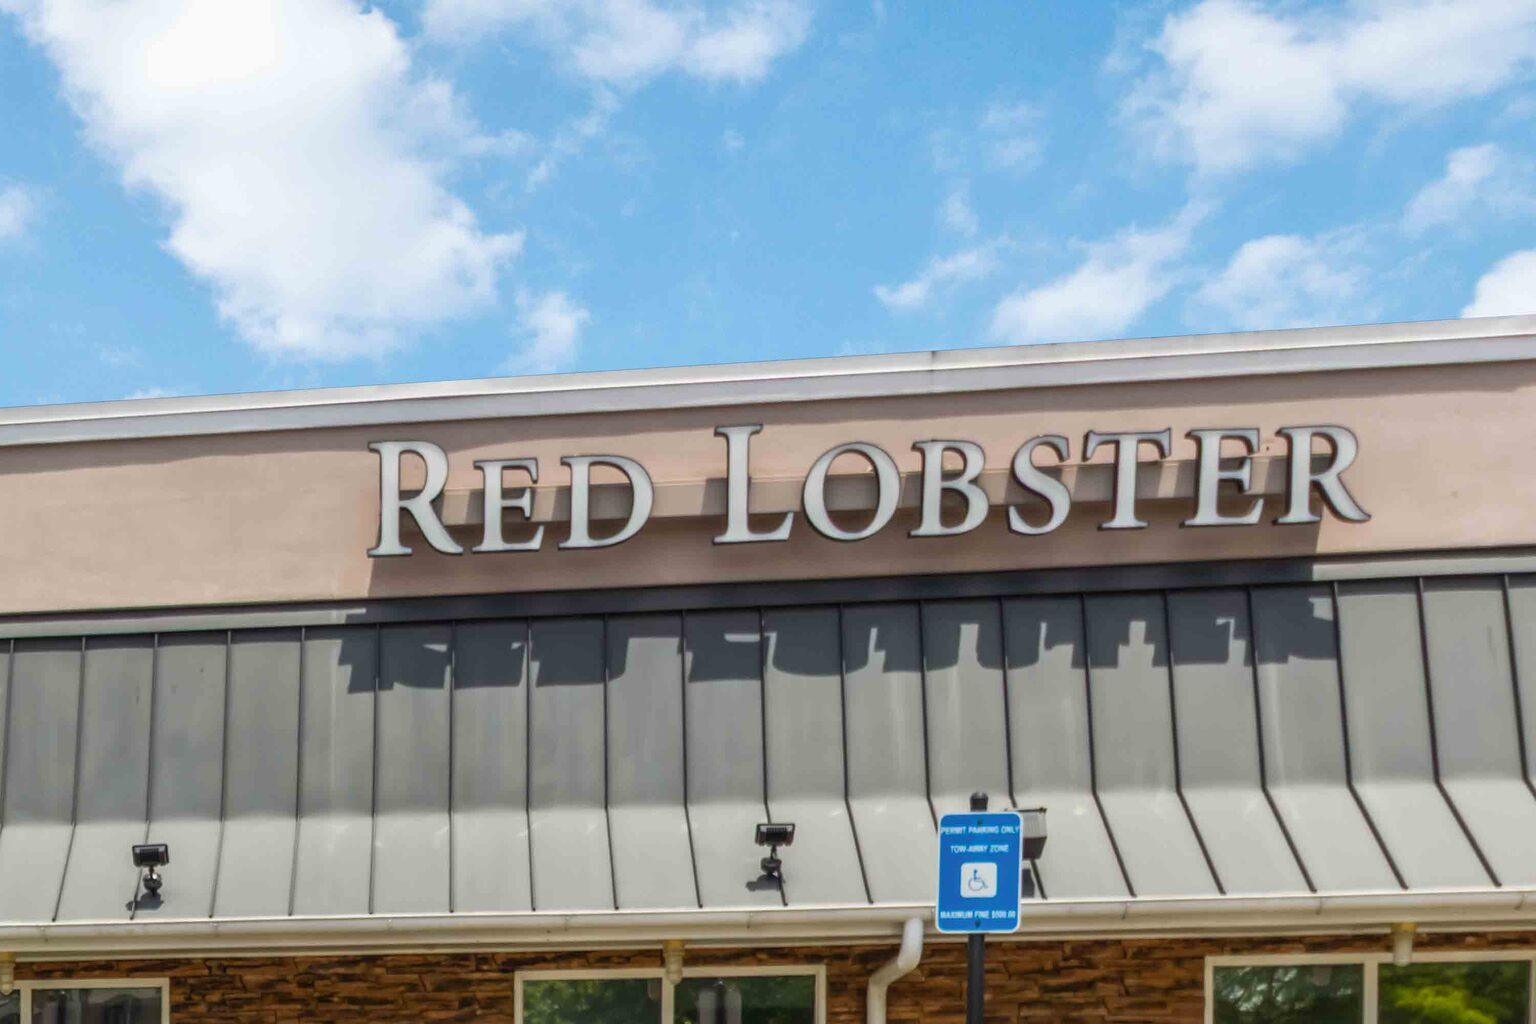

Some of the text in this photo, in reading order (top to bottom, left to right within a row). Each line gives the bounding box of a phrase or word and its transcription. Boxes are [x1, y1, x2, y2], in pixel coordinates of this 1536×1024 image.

[366, 422, 1372, 558] RED LOBSTER
[968, 825, 999, 834] PARKING
[1001, 825, 1020, 834] ONLY
[990, 844, 1009, 853] ZONE
